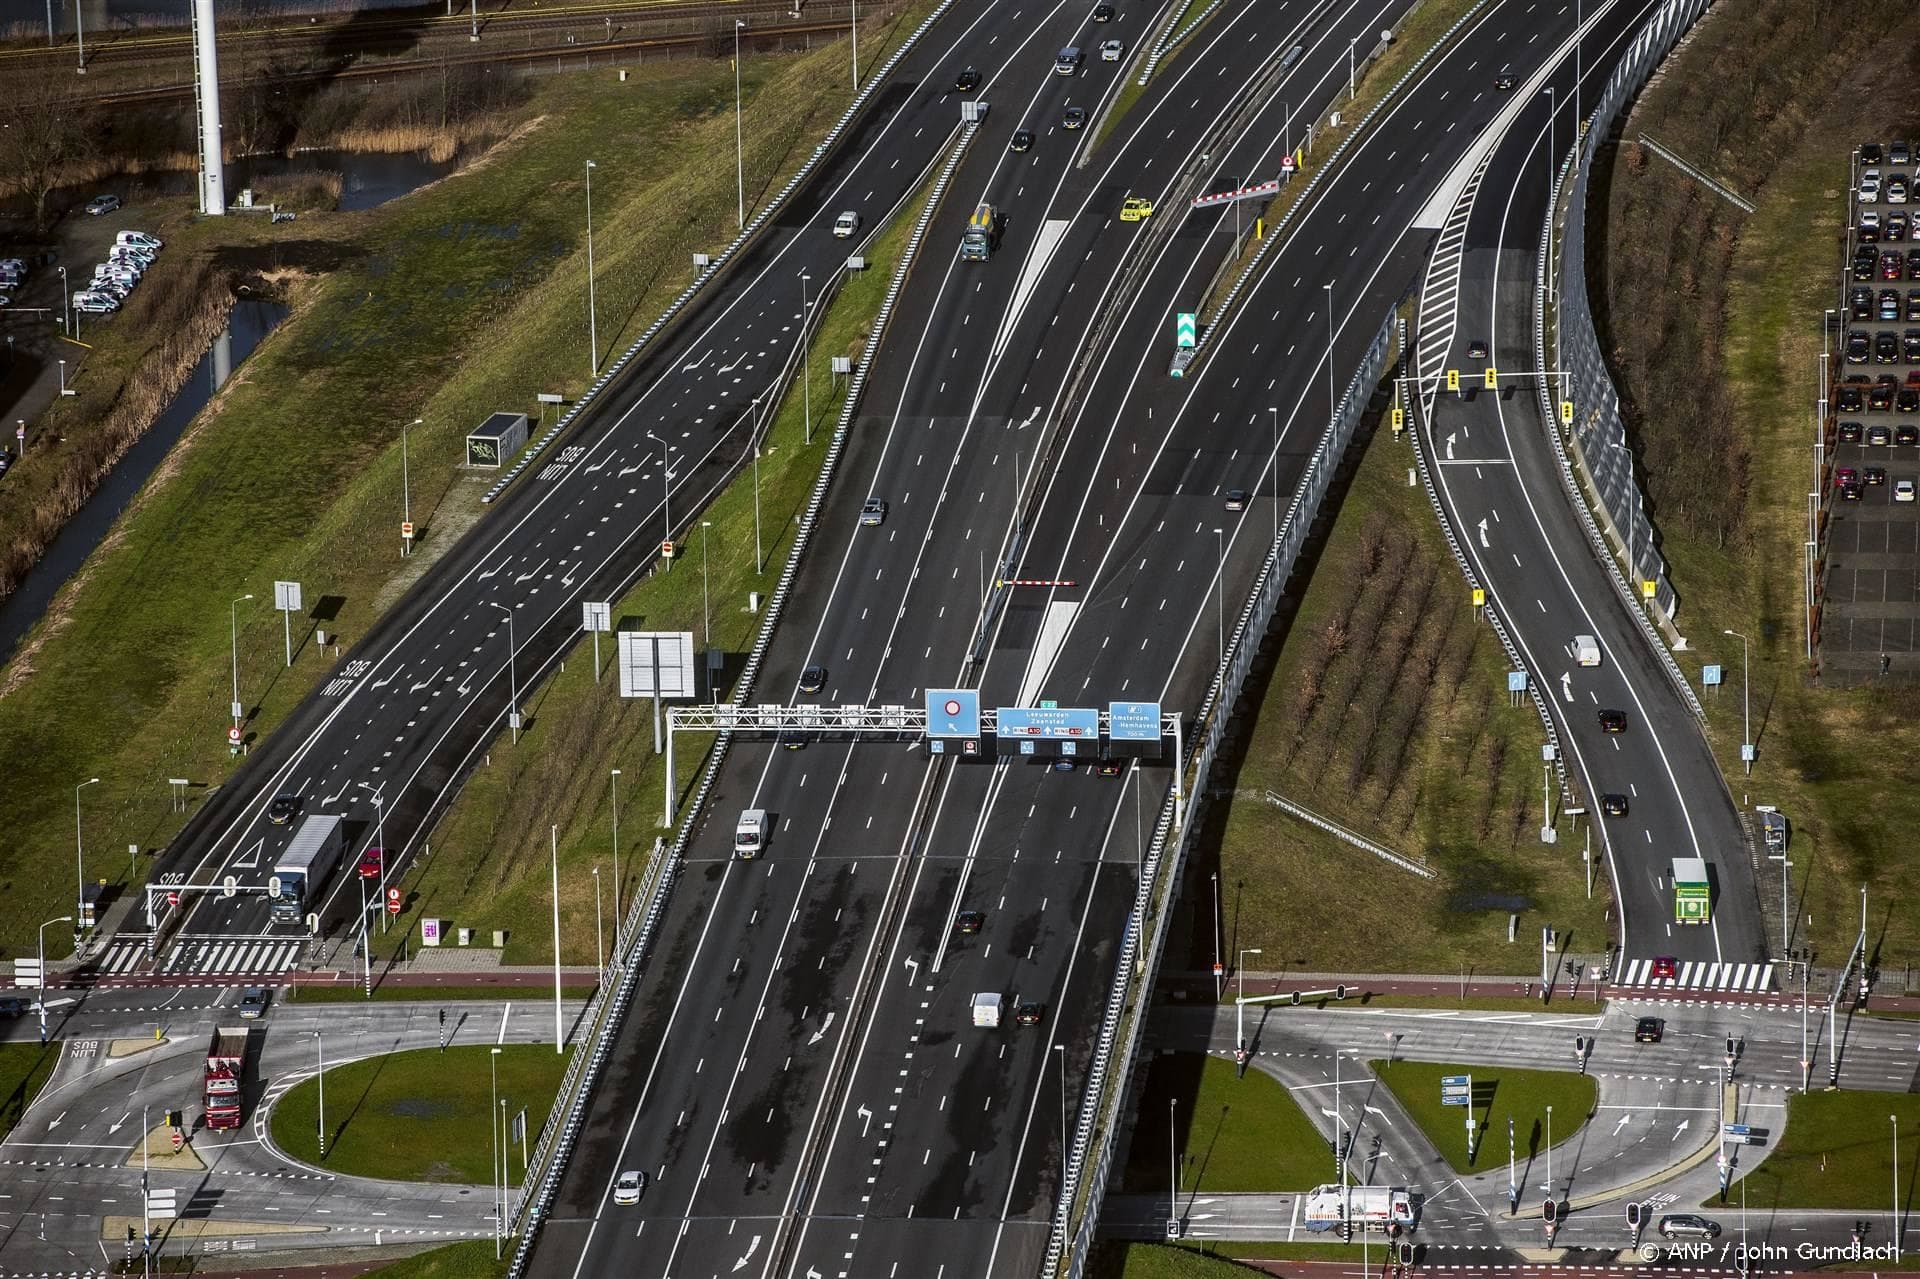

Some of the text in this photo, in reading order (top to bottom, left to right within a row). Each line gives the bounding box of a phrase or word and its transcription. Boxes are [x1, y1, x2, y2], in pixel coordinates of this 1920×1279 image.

[555, 446, 587, 462] BUS
[339, 660, 372, 677] BUS
[73, 1041, 98, 1050] BUS
